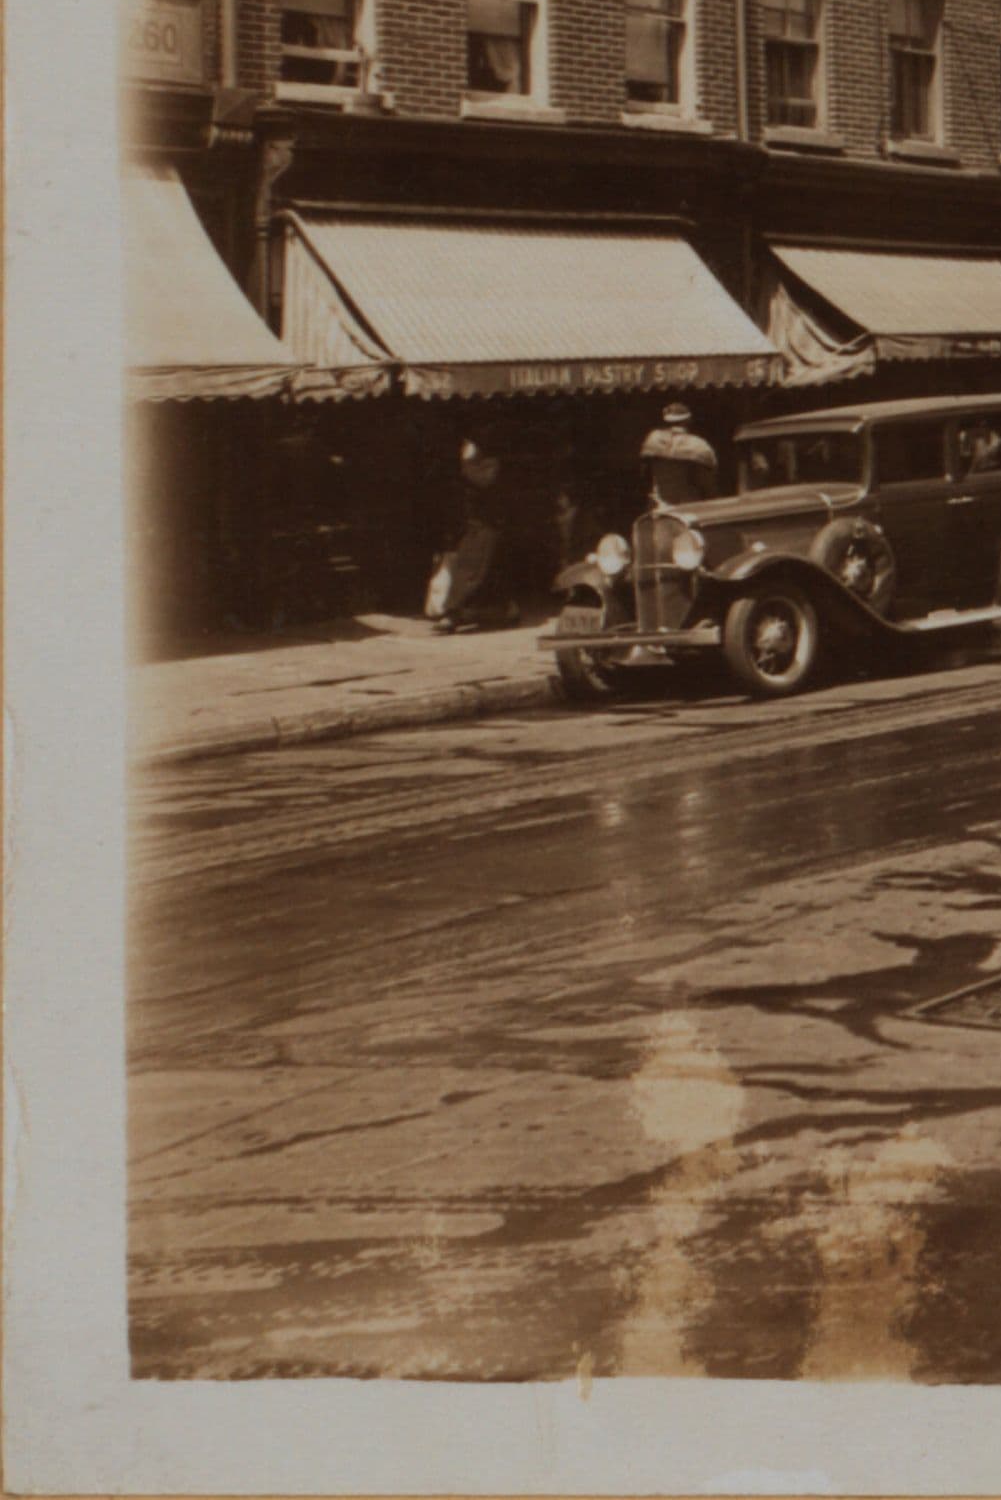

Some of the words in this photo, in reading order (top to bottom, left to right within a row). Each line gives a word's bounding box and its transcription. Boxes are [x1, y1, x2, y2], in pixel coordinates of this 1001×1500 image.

[509, 365, 571, 388] ITALIAN
[582, 362, 645, 385] PASTRY
[654, 360, 699, 382] SHOP
